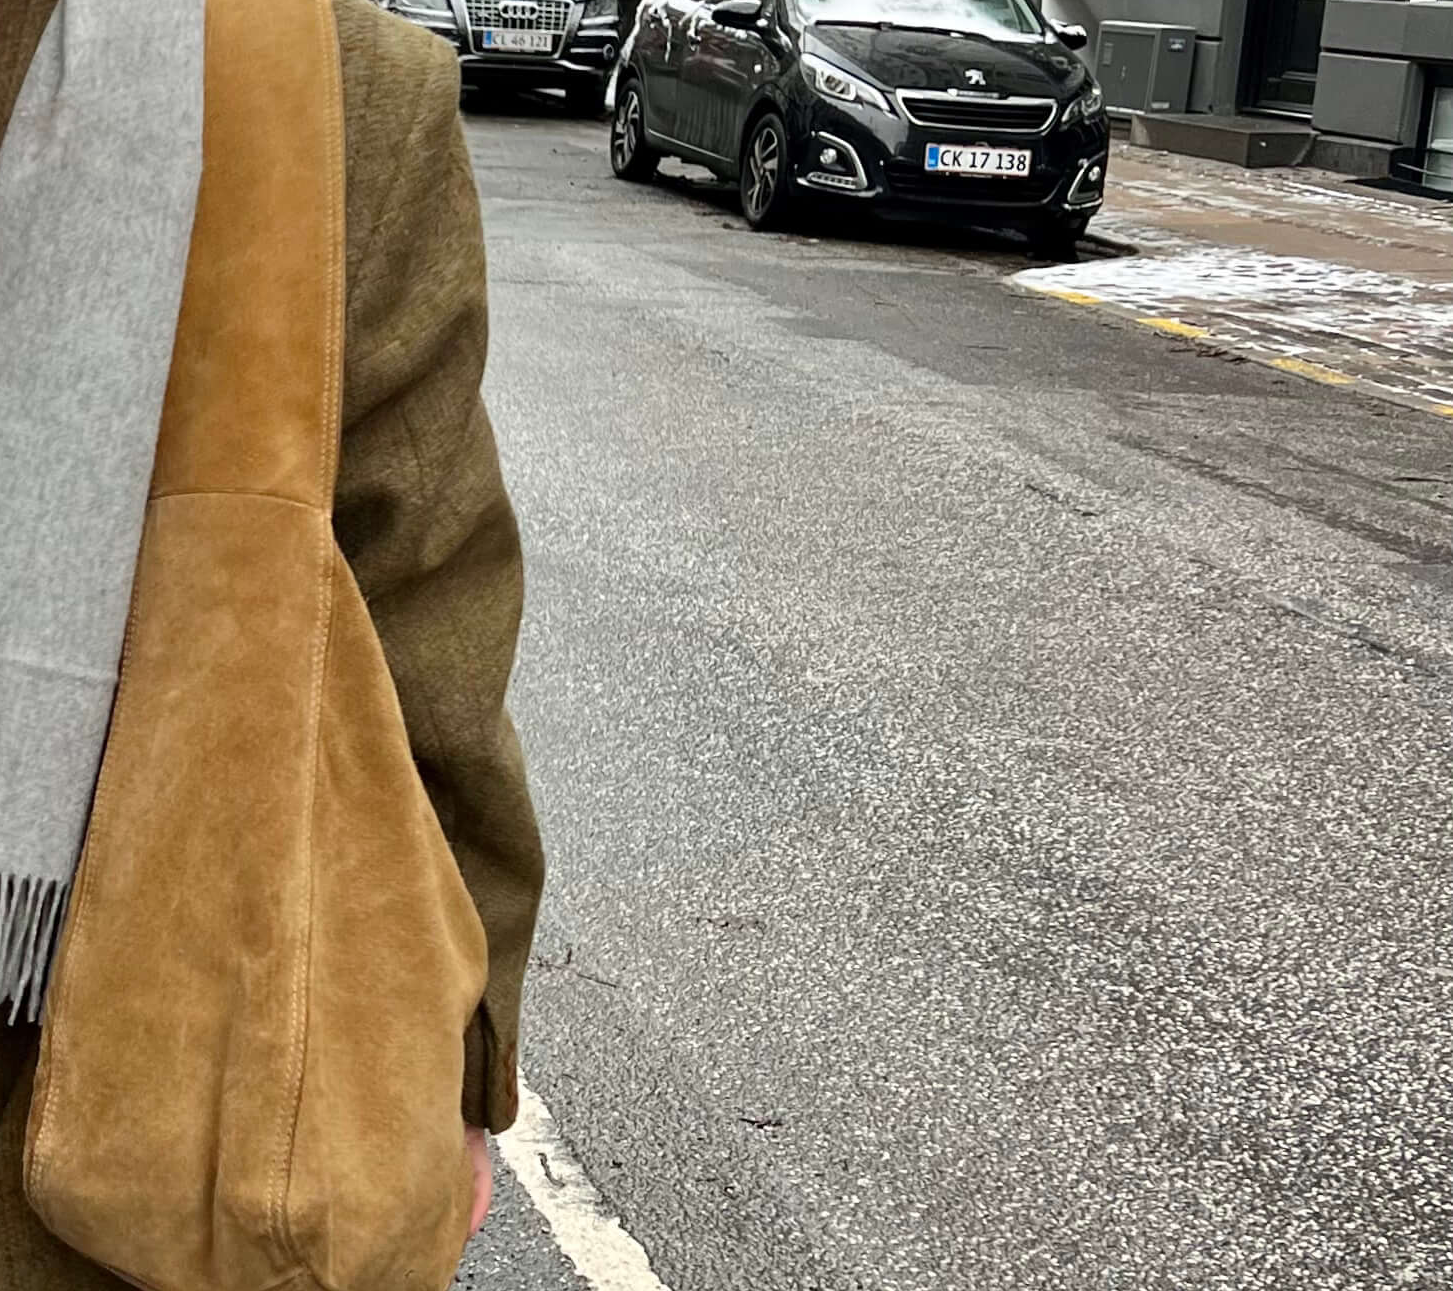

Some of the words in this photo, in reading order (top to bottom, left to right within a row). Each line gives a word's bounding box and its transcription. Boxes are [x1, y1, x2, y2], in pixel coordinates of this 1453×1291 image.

[940, 149, 963, 167] CK
[969, 152, 990, 169] 17
[995, 154, 1027, 171] 138
